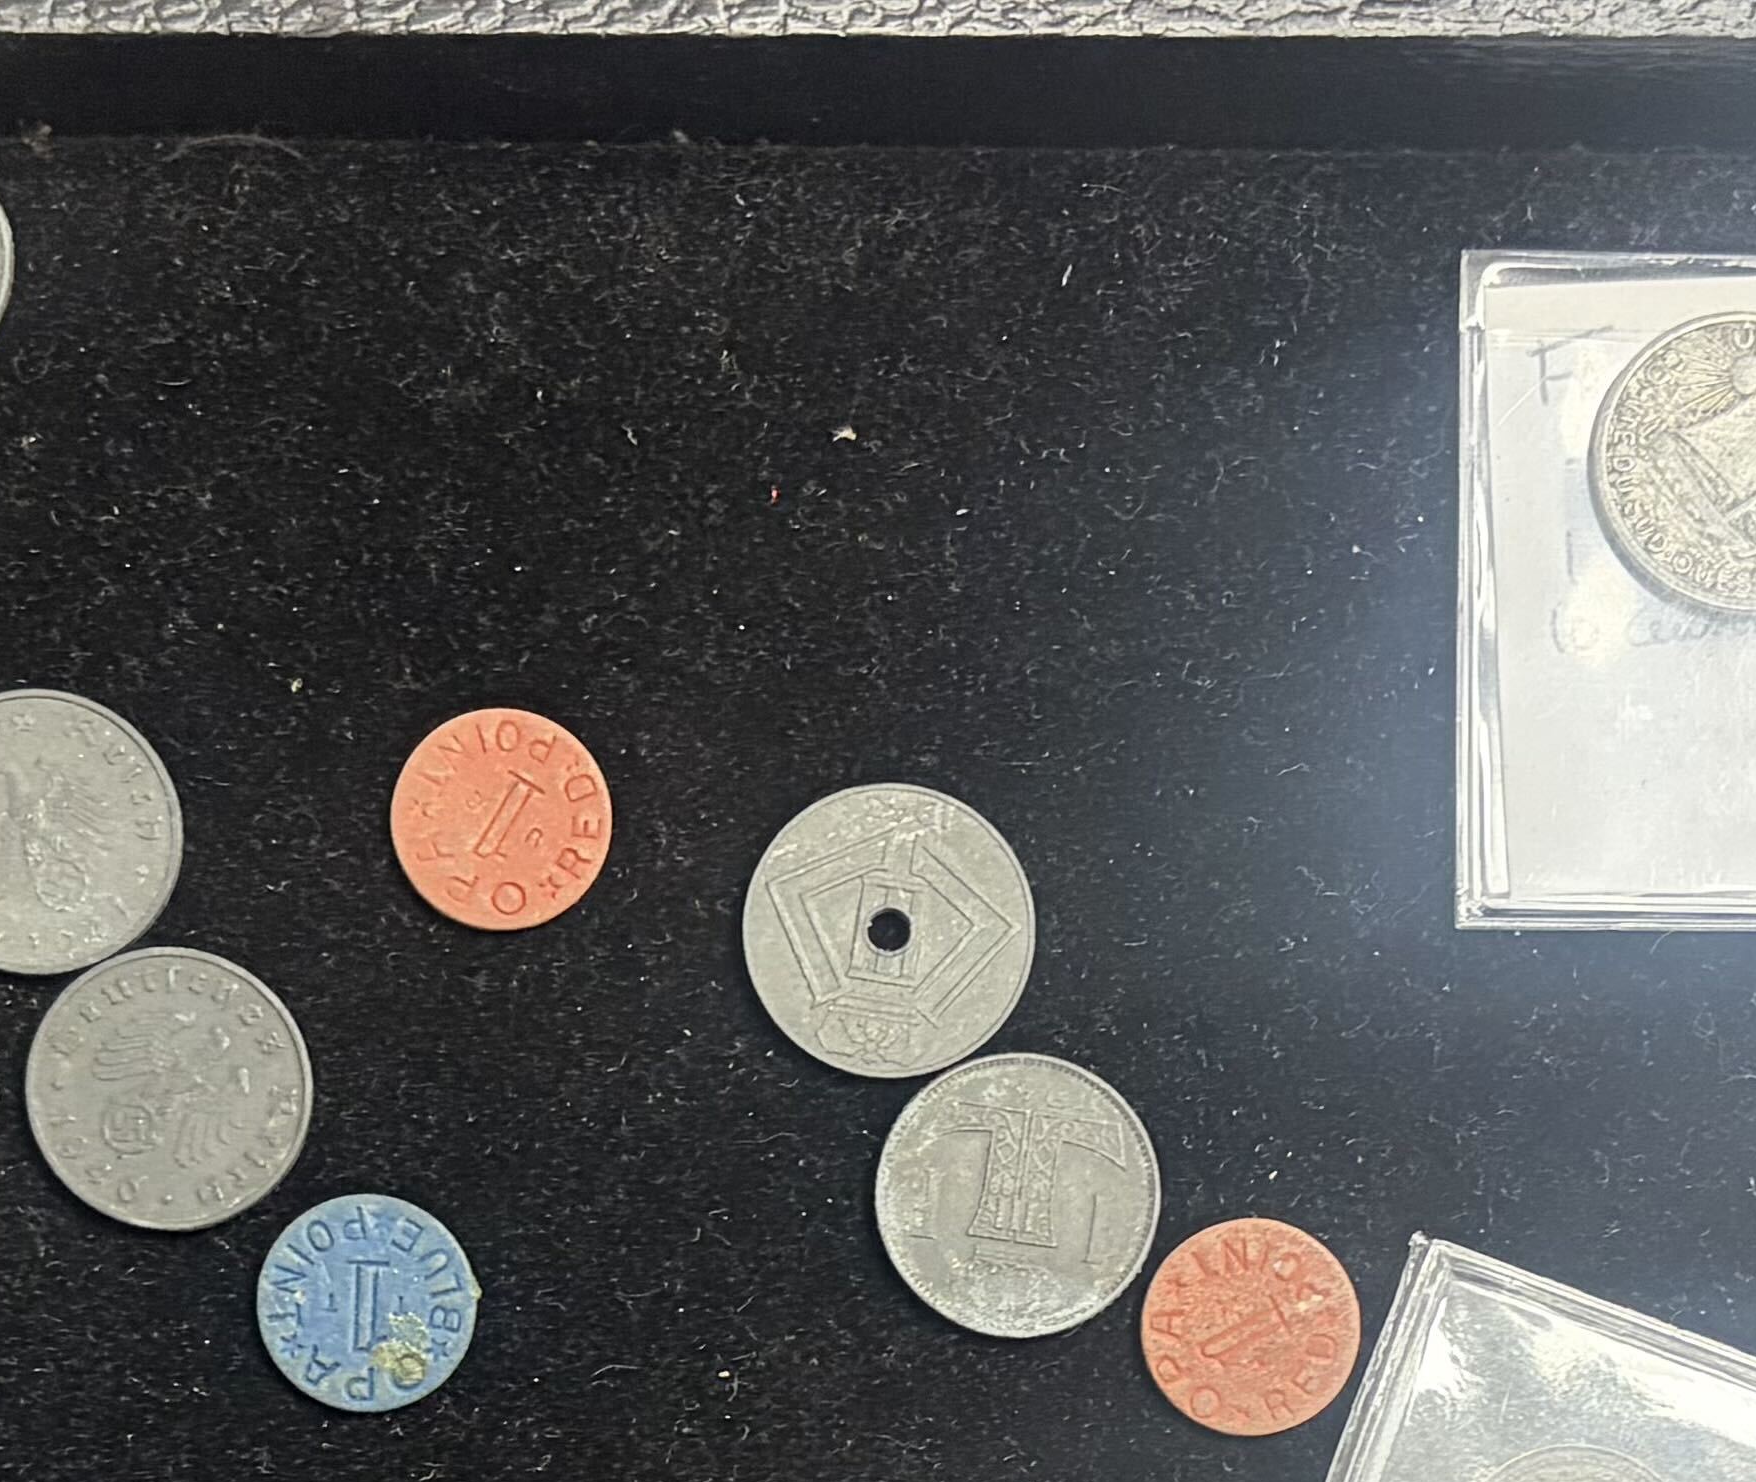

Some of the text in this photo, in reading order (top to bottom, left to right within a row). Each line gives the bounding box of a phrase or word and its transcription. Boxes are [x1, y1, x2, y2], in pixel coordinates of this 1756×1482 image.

[414, 718, 603, 881] RED POINT
[266, 1205, 463, 1333] BLUE POINT
[1264, 1332, 1337, 1421] RED
